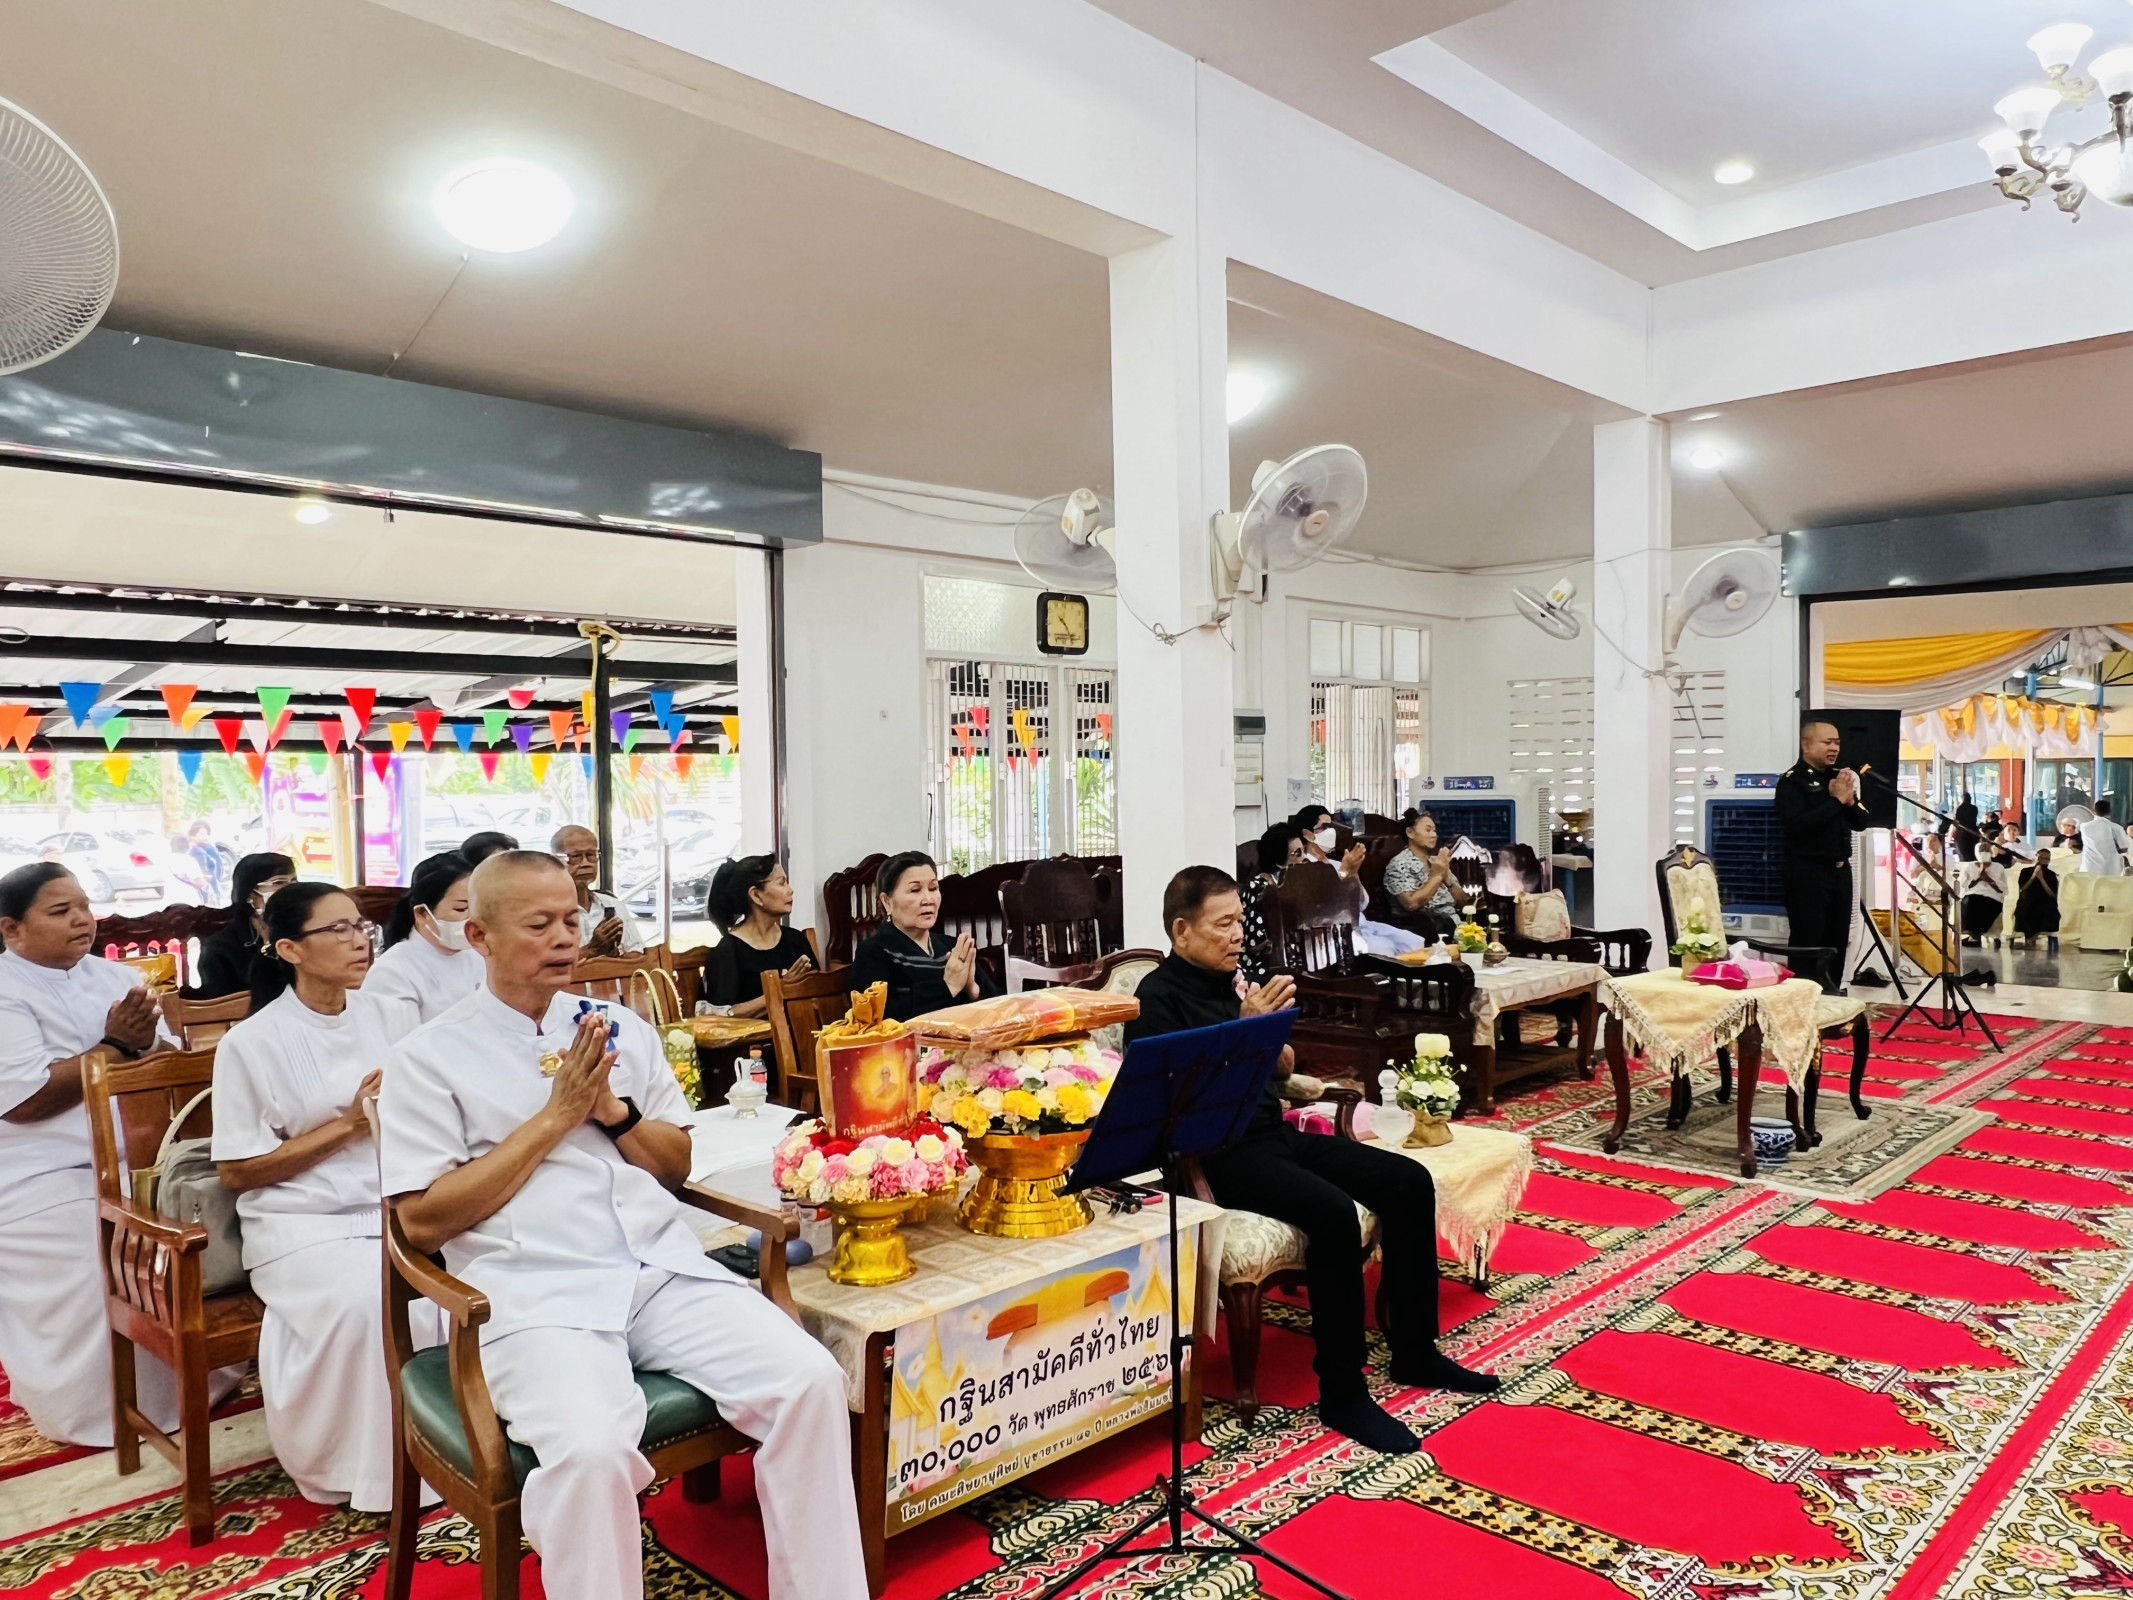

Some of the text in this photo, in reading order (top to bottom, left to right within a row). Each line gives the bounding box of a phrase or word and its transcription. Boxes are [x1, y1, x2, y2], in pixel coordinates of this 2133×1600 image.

[900, 1353, 1170, 1483] ๓๐,๐๐๐ วัด พุทธศักราช ๒๕๖
[940, 1315, 1160, 1426] กฐินสามัคคีทั่วไทย
[901, 1501, 926, 1521] โดย
[1023, 1436, 1073, 1470] บูชาธรรม
[1105, 1386, 1173, 1429] หลวงพ่อธัมมชโ
